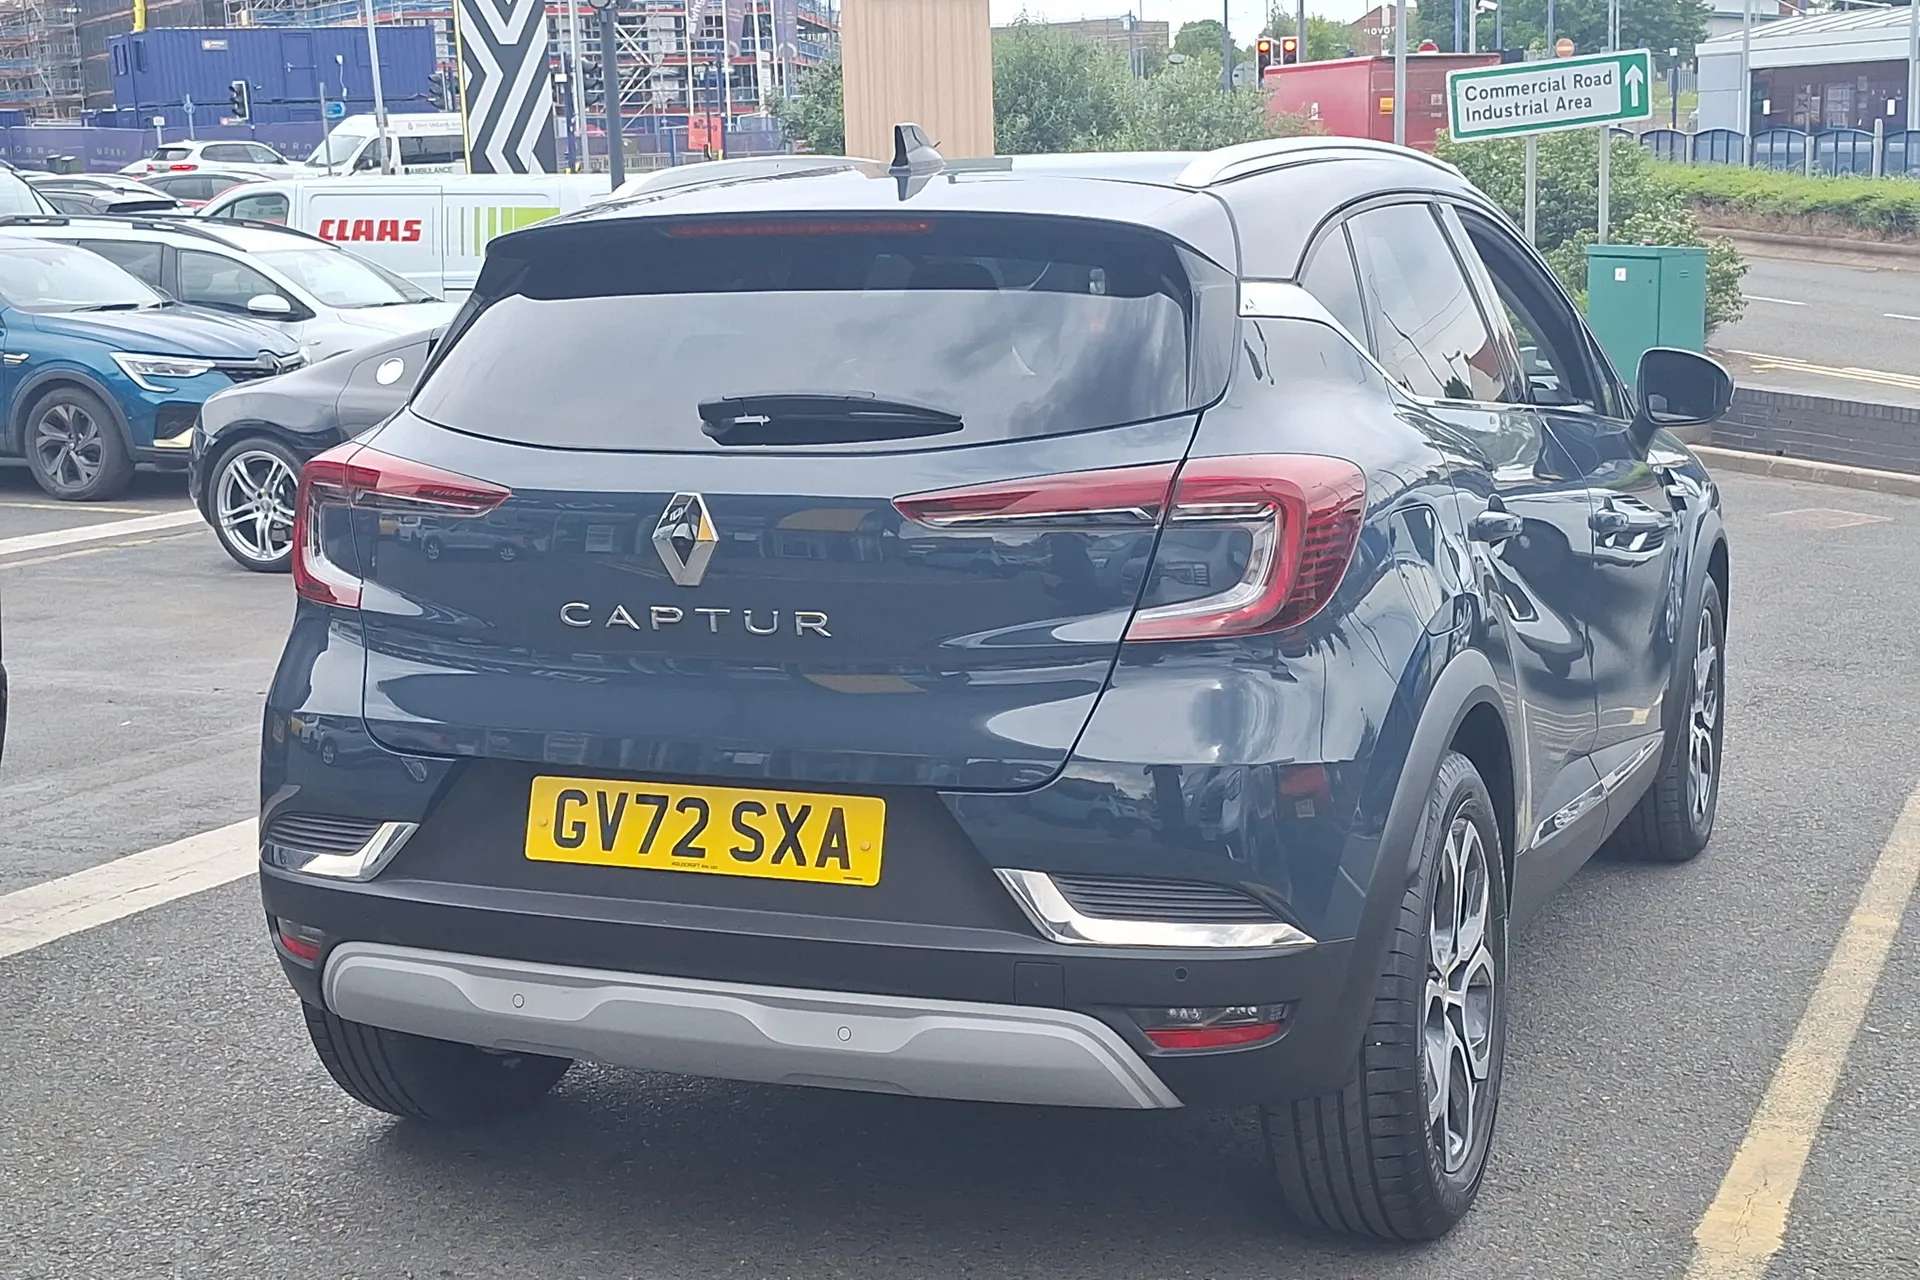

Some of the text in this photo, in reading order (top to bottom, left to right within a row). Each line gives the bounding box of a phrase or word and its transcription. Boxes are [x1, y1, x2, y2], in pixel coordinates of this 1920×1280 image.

[1465, 70, 1613, 102] Commercial Road
[1465, 95, 1592, 122] Industrial Area
[318, 219, 422, 242] CLAAS
[559, 602, 832, 638] CAPTUR
[553, 789, 851, 871] GV72 SXA
